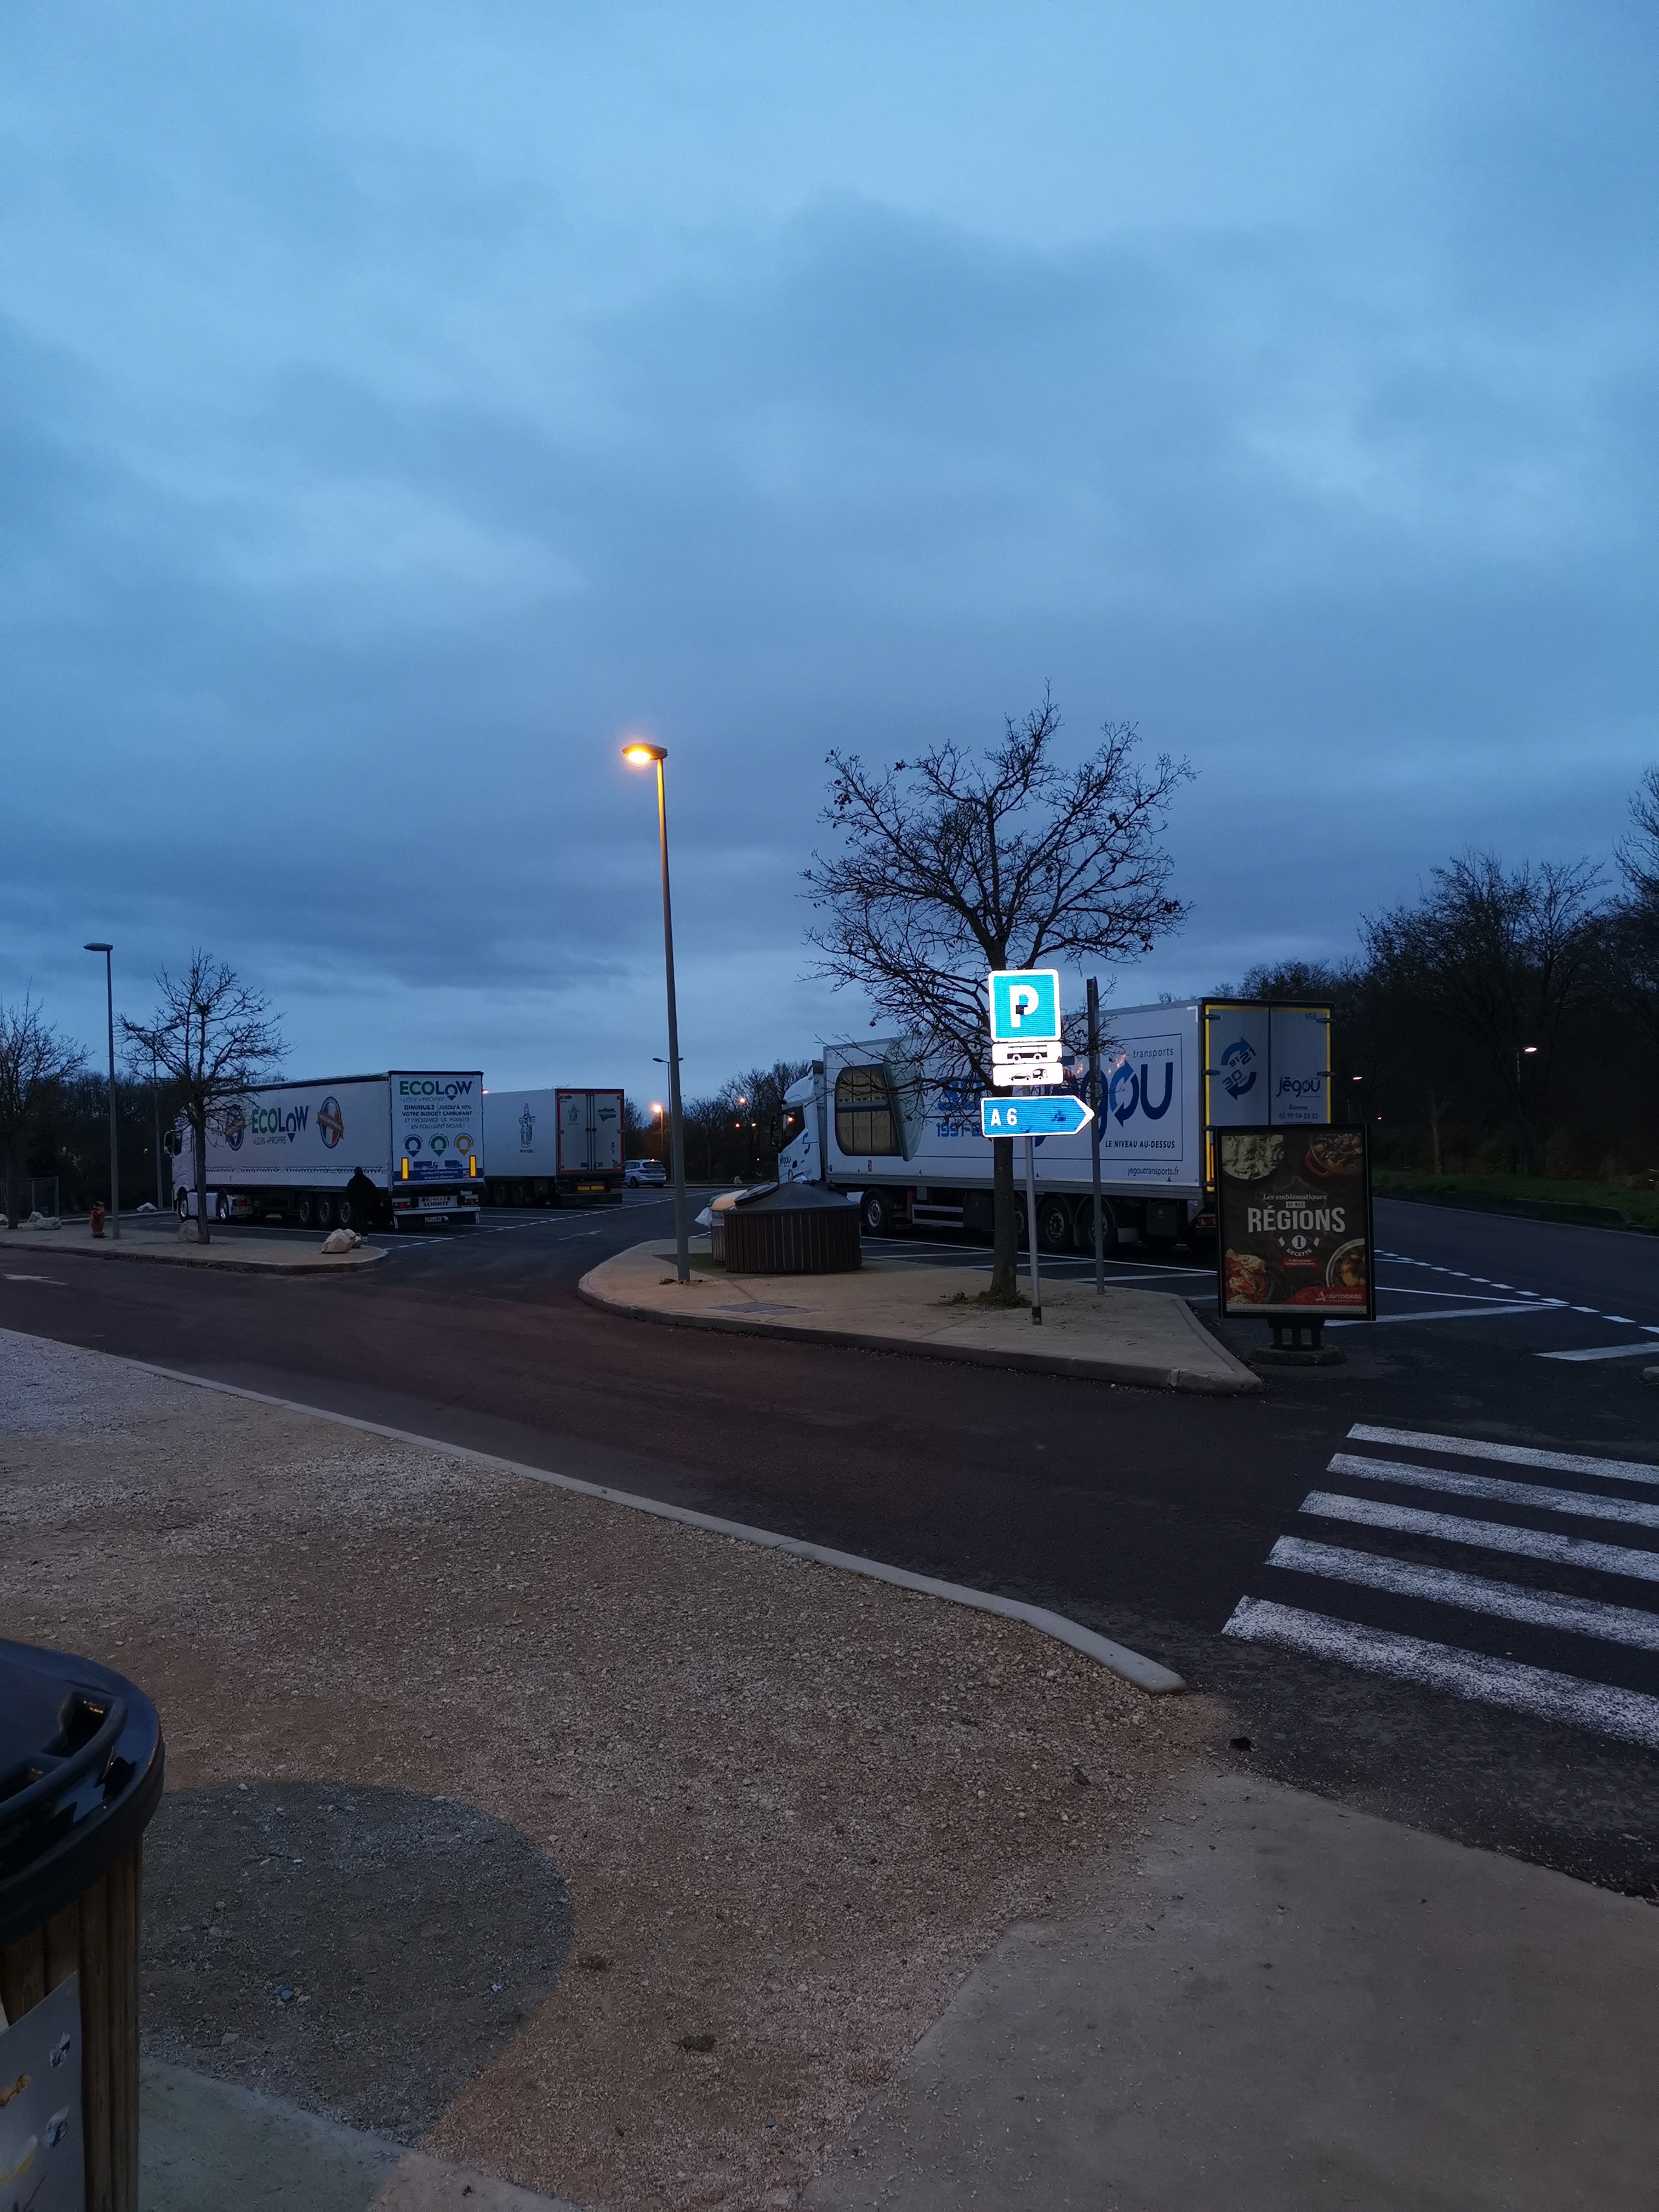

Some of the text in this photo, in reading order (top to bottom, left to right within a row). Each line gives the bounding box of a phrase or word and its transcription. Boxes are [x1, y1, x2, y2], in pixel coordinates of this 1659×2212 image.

[1009, 985, 1039, 1028] P
[1133, 1048, 1173, 1059] transports
[1222, 1069, 1242, 1090] 30
[991, 1108, 1017, 1126] A 6
[1127, 1166, 1179, 1177] jegoutransports.fr
[1275, 1193, 1327, 1201] emblématiques
[1247, 1205, 1346, 1233] RÉGIONS
[1296, 1237, 1302, 1248] 1
[1286, 1248, 1313, 1256] RECETTE
